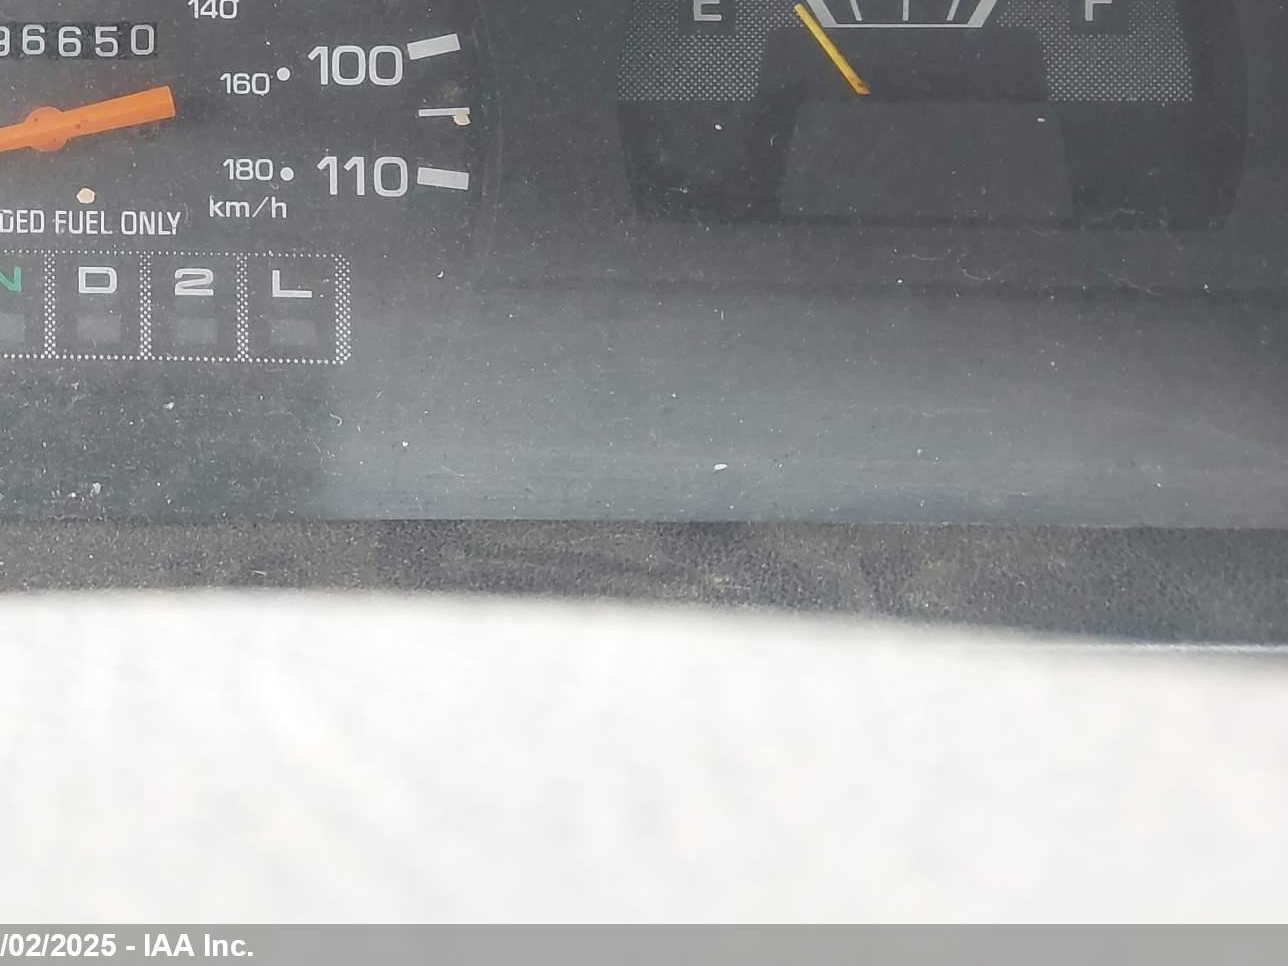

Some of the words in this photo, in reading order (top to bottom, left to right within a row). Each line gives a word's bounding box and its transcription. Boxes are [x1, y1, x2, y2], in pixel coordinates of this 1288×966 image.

[307, 45, 403, 86] 100
[220, 72, 270, 95] 160
[222, 158, 273, 181] 180
[316, 156, 408, 197] 110
[209, 196, 287, 219] km/h
[55, 210, 112, 234] FUEL
[120, 211, 181, 235] ONLY
[78, 266, 117, 294] D
[174, 268, 214, 296] 2
[272, 270, 312, 298] L
